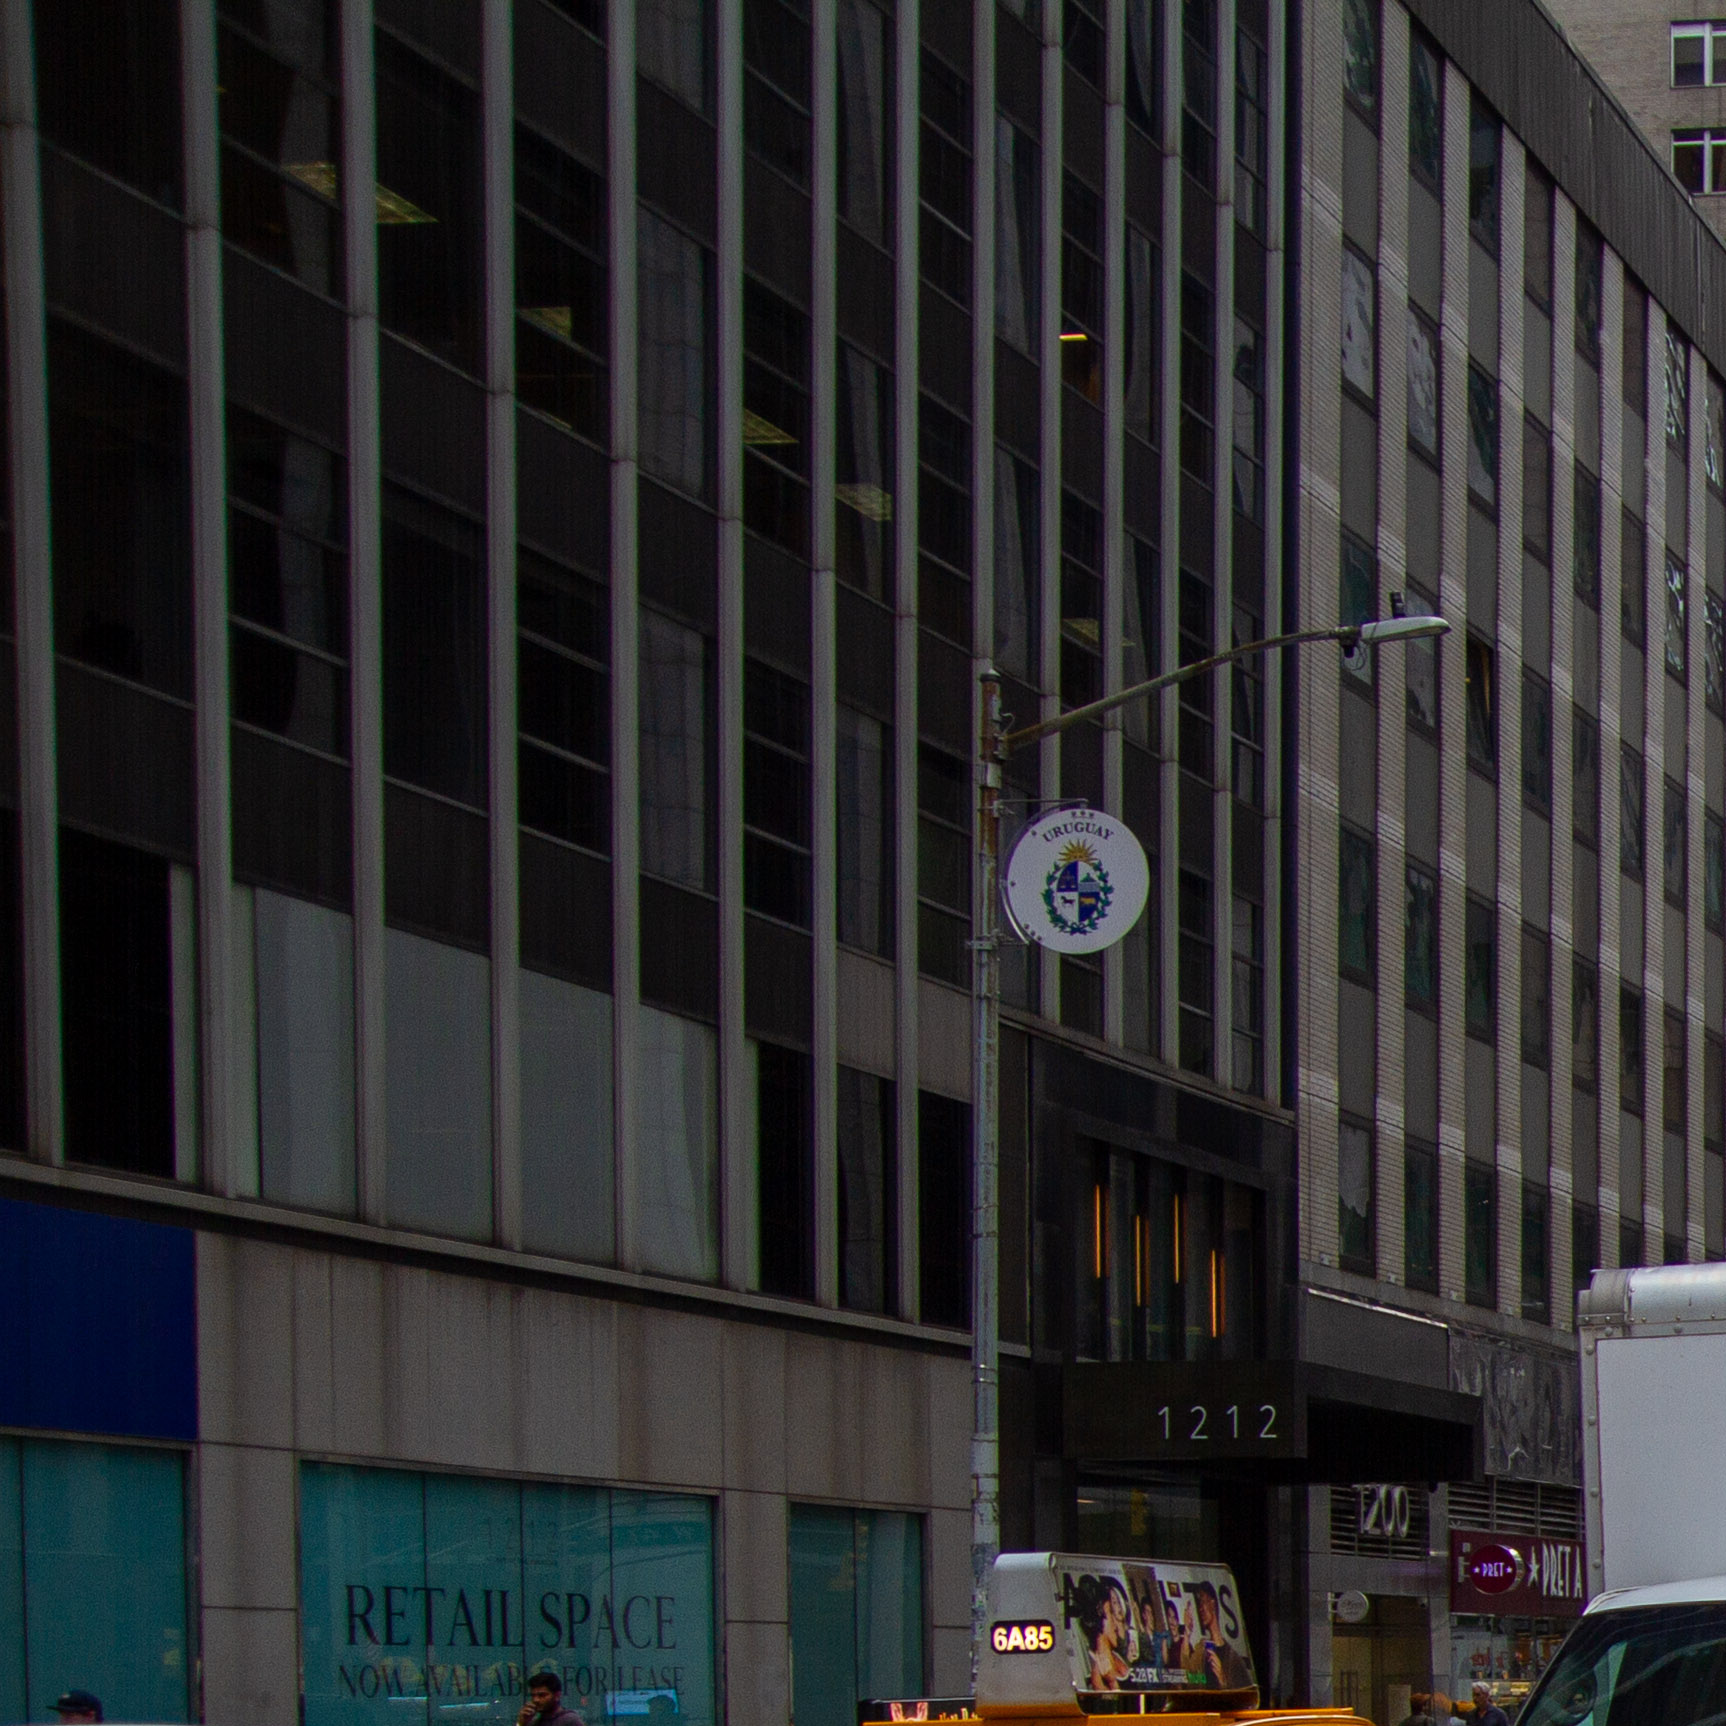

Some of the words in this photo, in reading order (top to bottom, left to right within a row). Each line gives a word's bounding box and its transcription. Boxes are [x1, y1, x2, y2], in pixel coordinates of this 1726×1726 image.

[1042, 822, 1114, 842] URUGUAY
[1157, 1404, 1278, 1440] 1212
[1482, 1562, 1505, 1577] PRET
[1542, 1543, 1571, 1598] PRET
[1574, 1546, 1583, 1598] A
[346, 1584, 525, 1648] RETAIL
[540, 1591, 677, 1650] SPACE
[993, 1625, 1053, 1651] 6A85
[339, 1665, 407, 1698] NOW
[417, 1664, 550, 1698] AVAILAB
[562, 1666, 609, 1696] FOR
[616, 1666, 685, 1696] LEASE
